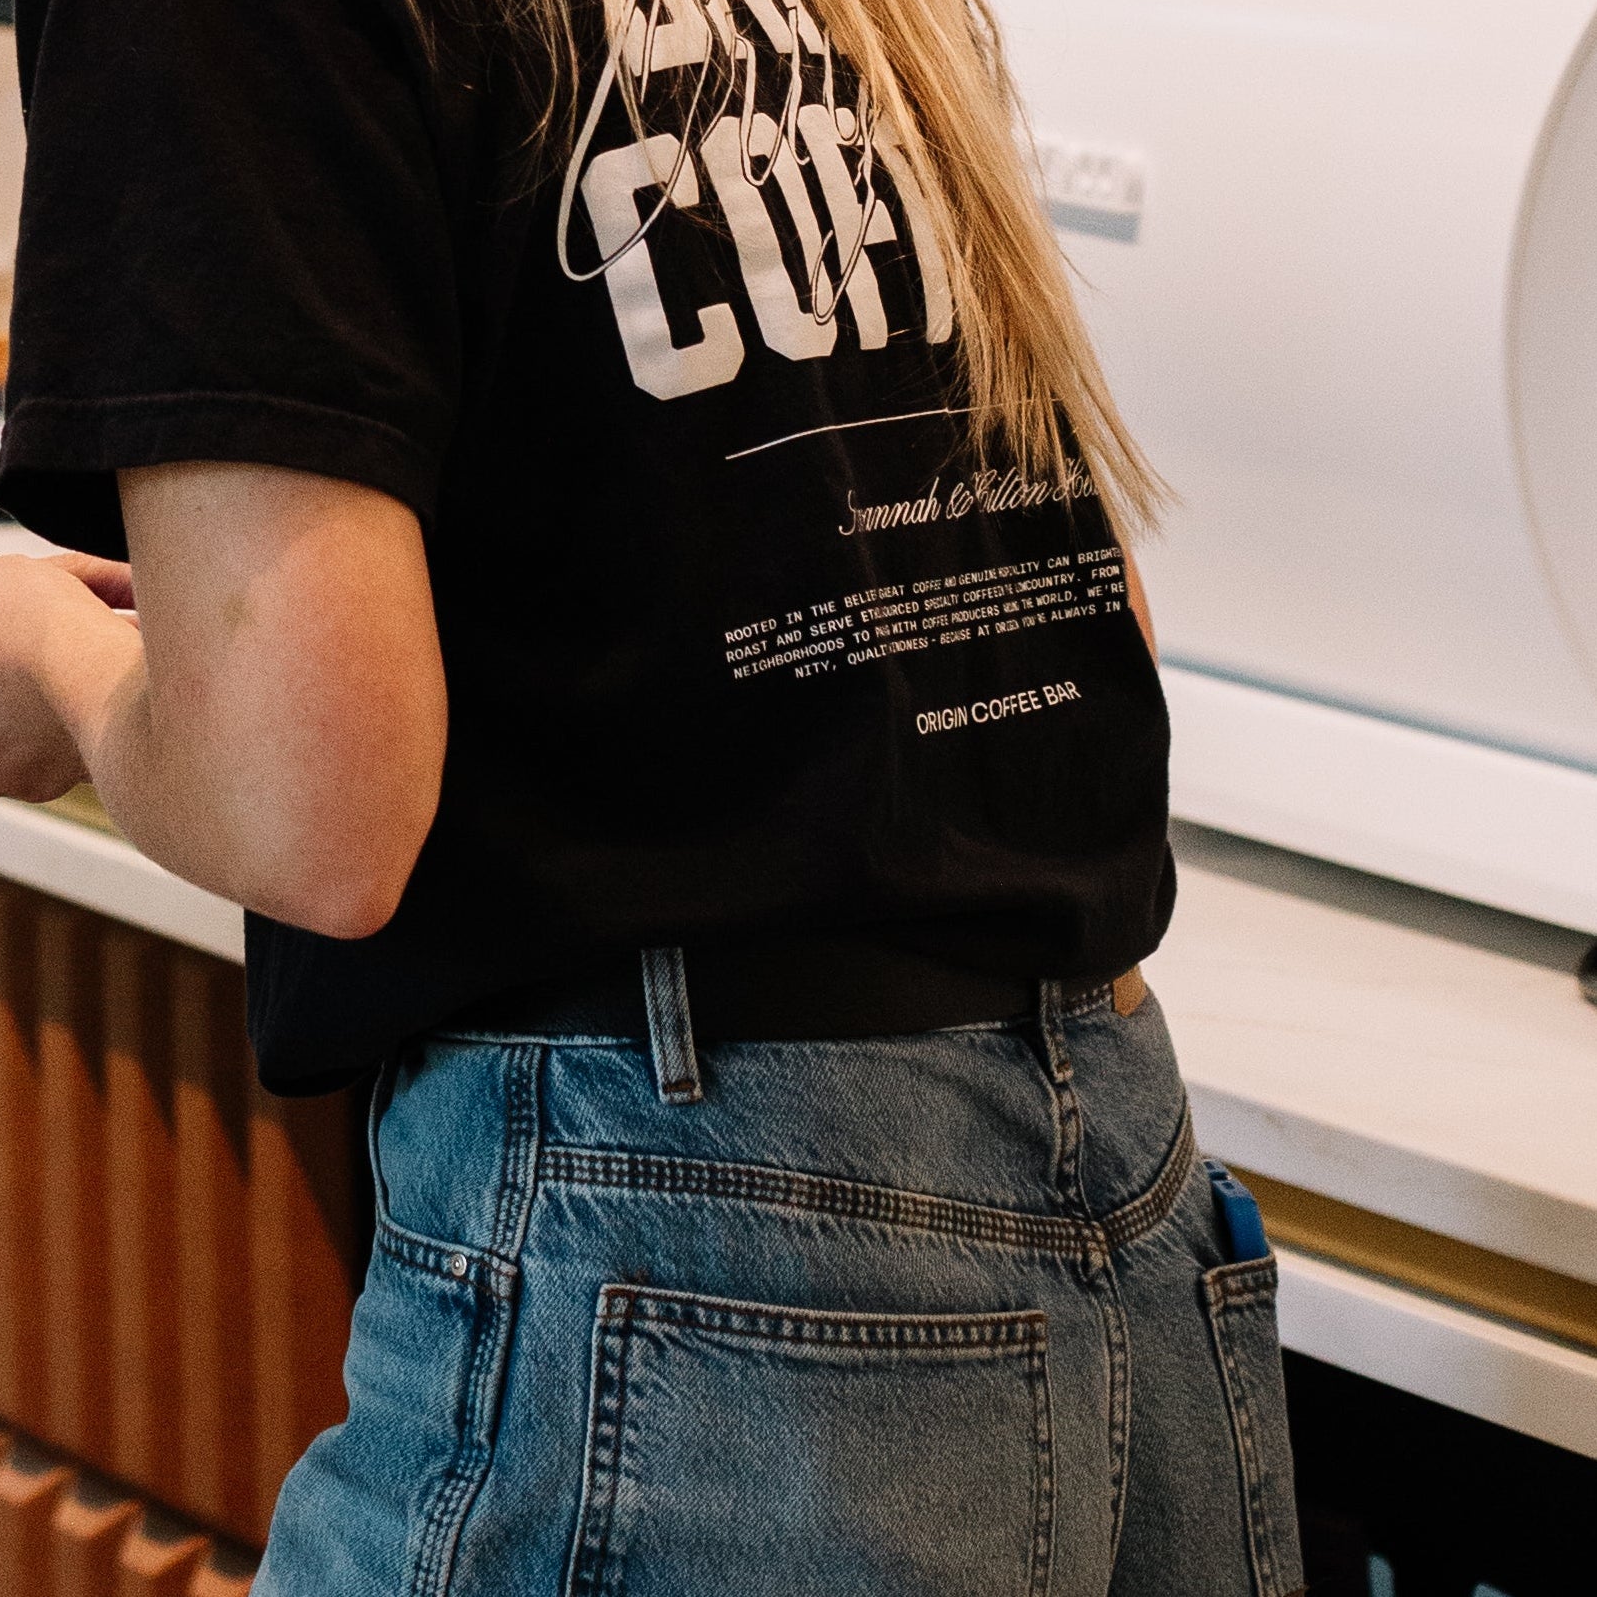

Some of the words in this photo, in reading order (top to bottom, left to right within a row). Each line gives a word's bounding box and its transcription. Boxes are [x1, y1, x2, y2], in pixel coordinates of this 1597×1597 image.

[724, 617, 777, 644] ROOTED
[785, 610, 804, 625] IN
[810, 600, 838, 617] THE
[912, 579, 942, 594] COFFEE
[1047, 555, 1071, 569] CAN
[725, 640, 769, 663] ROAST
[776, 629, 803, 647] AND
[809, 614, 854, 637] SERVE
[1091, 564, 1121, 581] FROM
[732, 637, 846, 680] NEIGHBORHOODS
[852, 629, 871, 645] TO
[921, 614, 950, 630] COFFEE
[951, 604, 1001, 624] PRODUCERS
[1036, 589, 1079, 607] WORLD,
[1087, 581, 1126, 598] WE'RE
[794, 659, 838, 679] NITY,
[977, 623, 991, 637] AT
[1050, 604, 1098, 622] ALWAYS
[1104, 600, 1122, 614] IN
[915, 705, 969, 735] ORIGIN
[971, 689, 1043, 724] COFFEE
[1042, 680, 1083, 706] BAR
